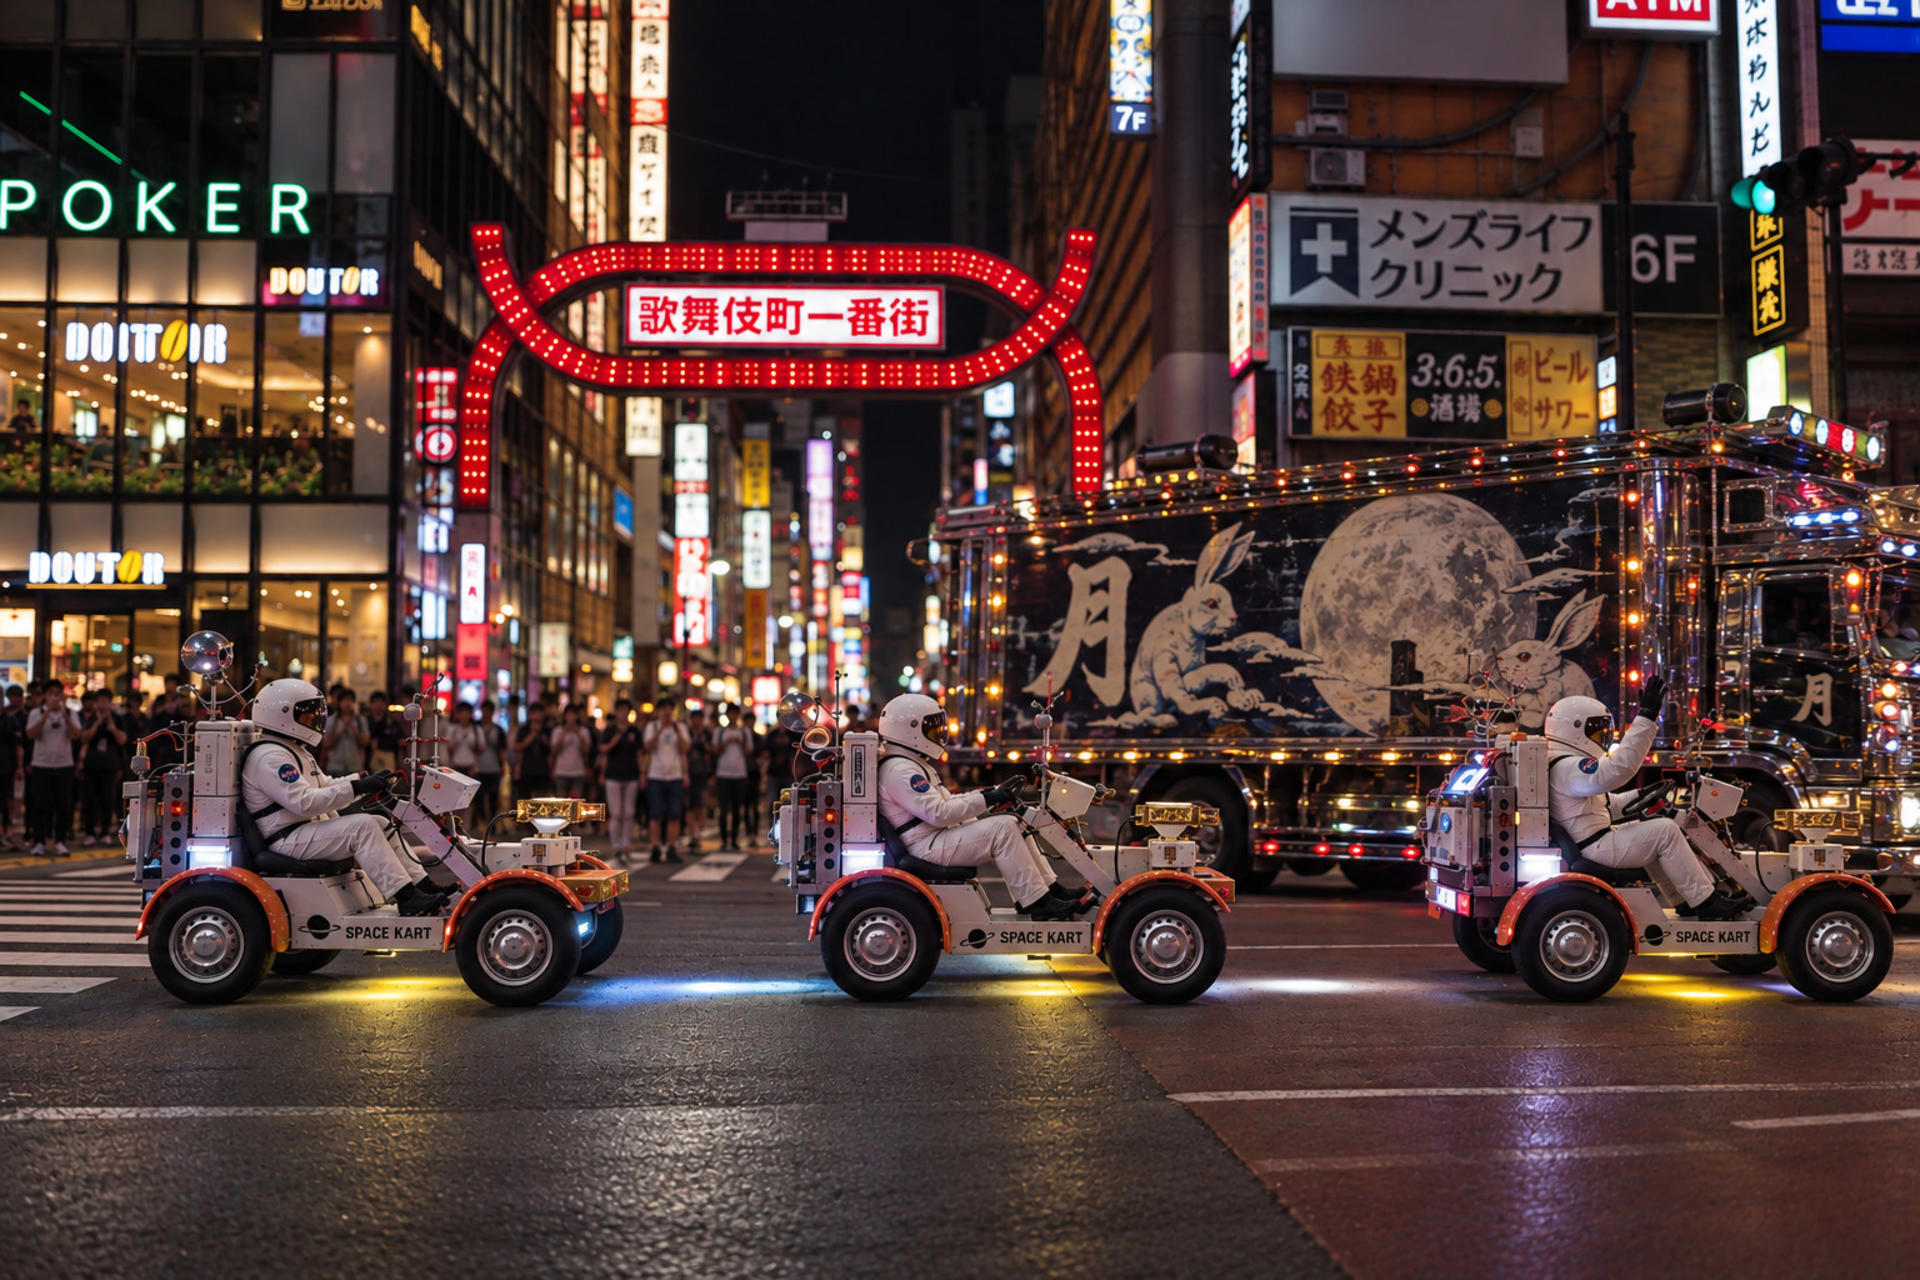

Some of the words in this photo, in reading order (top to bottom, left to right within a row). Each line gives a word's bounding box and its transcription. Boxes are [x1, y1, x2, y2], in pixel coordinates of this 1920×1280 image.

[1116, 106, 1146, 131] 7F
[0, 180, 310, 234] POKER
[1370, 208, 1592, 253] メンズライフ
[1631, 233, 1698, 283] 6F
[269, 266, 379, 295] DOUTOR
[1370, 258, 1563, 302] クリニック
[638, 296, 929, 337] 歌舞伎町一番街
[1320, 361, 1398, 397] 鉄鍋
[1535, 347, 1589, 384] ビール
[1320, 397, 1397, 433] 餃子
[1534, 397, 1591, 430] サワー
[28, 550, 165, 585] DOUTOR
[1022, 555, 1133, 708] 月
[1791, 672, 1833, 727] 月
[345, 926, 390, 940] SPACE
[394, 926, 432, 940] KART
[1000, 931, 1043, 944] SPACE
[1047, 931, 1083, 944] KART
[1676, 930, 1714, 944] SPACE
[1718, 930, 1751, 944] KART
